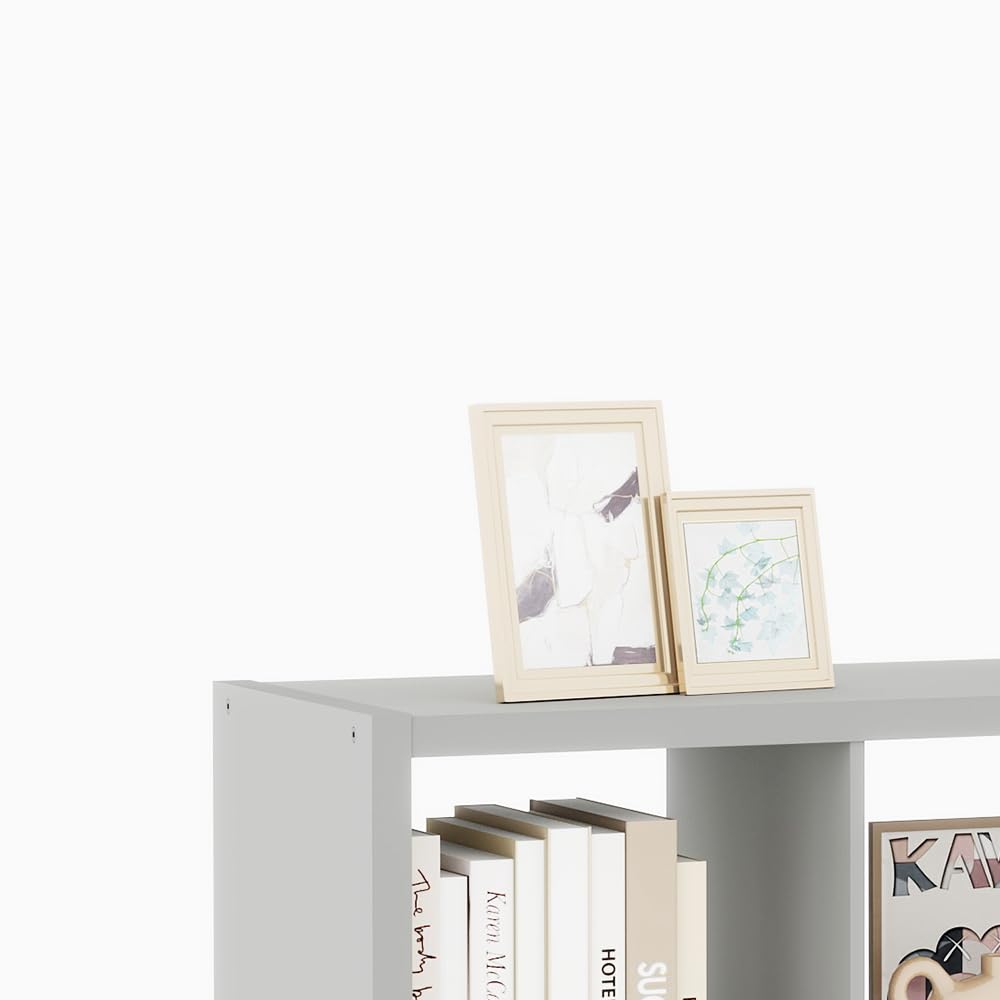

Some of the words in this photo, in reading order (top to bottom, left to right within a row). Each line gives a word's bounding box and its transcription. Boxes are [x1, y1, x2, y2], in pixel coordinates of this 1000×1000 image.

[412, 869, 431, 917] The
[485, 890, 507, 943] Karen
[412, 925, 437, 974] body
